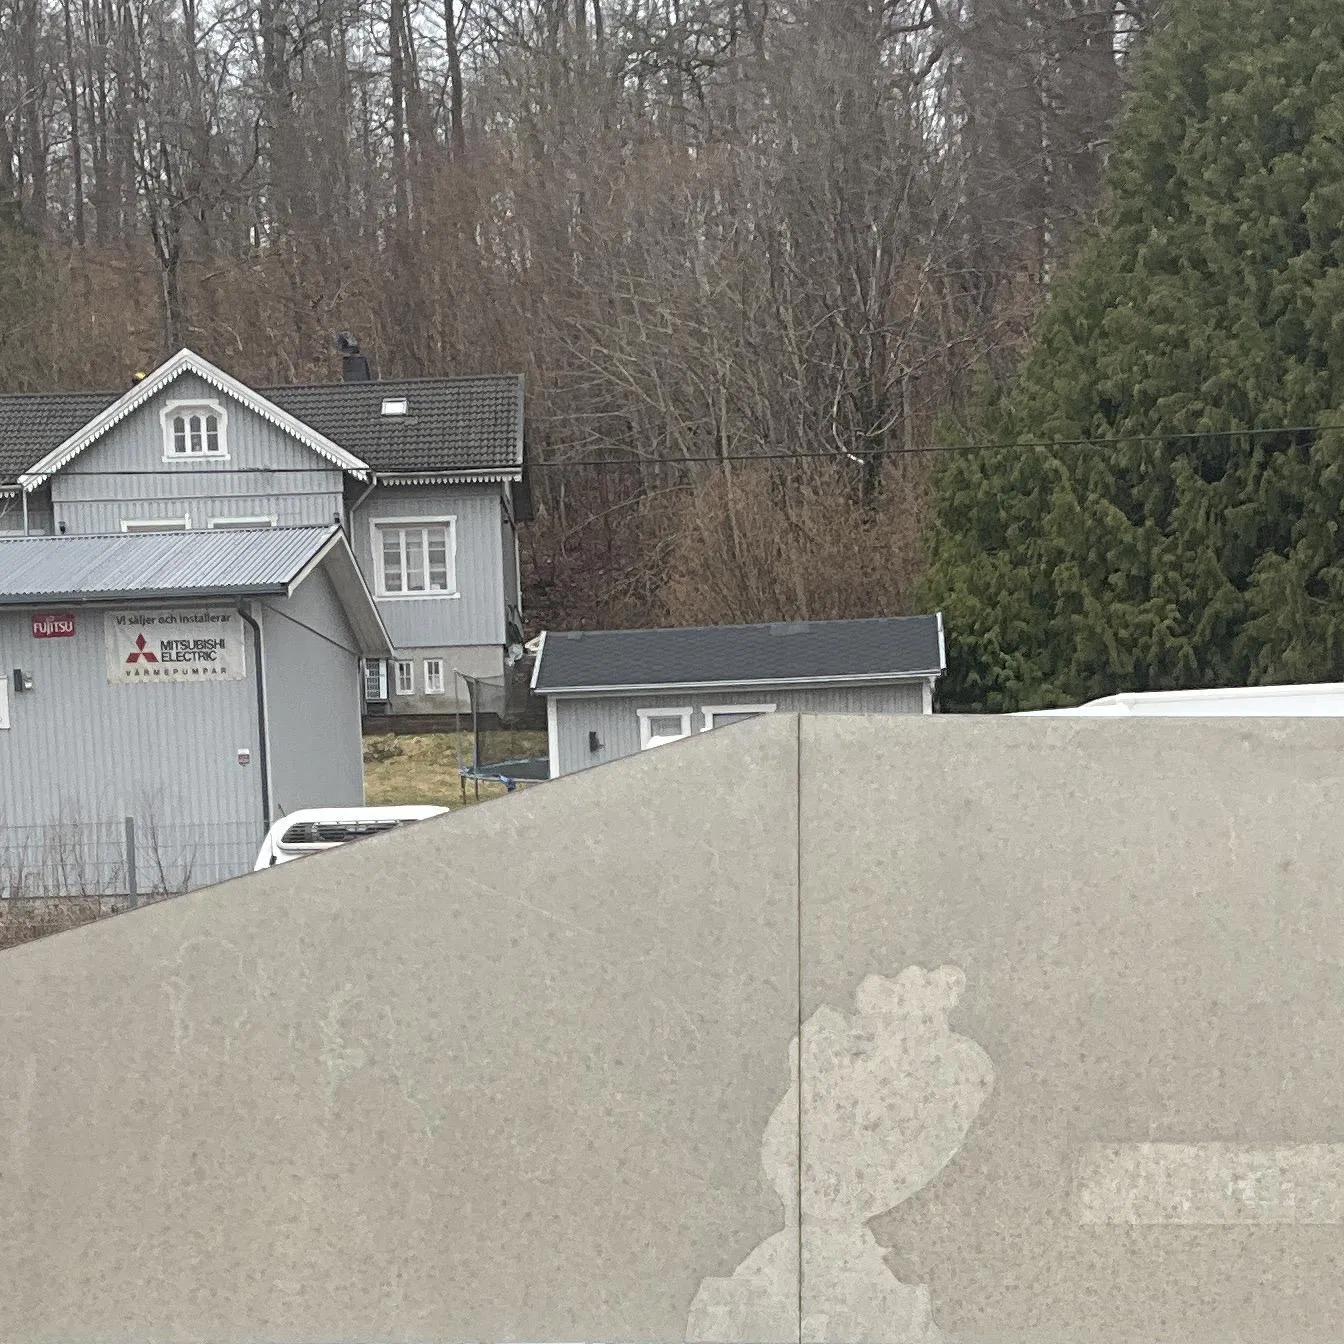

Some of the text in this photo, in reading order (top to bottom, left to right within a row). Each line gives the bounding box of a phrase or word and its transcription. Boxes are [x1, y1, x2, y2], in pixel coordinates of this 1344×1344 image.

[158, 614, 176, 625] och
[33, 620, 73, 636] FUJITSU
[160, 638, 226, 651] MITSUBISHI
[161, 650, 218, 663] ELECTRIC
[125, 667, 227, 677] VÄRMEPUMPAR
